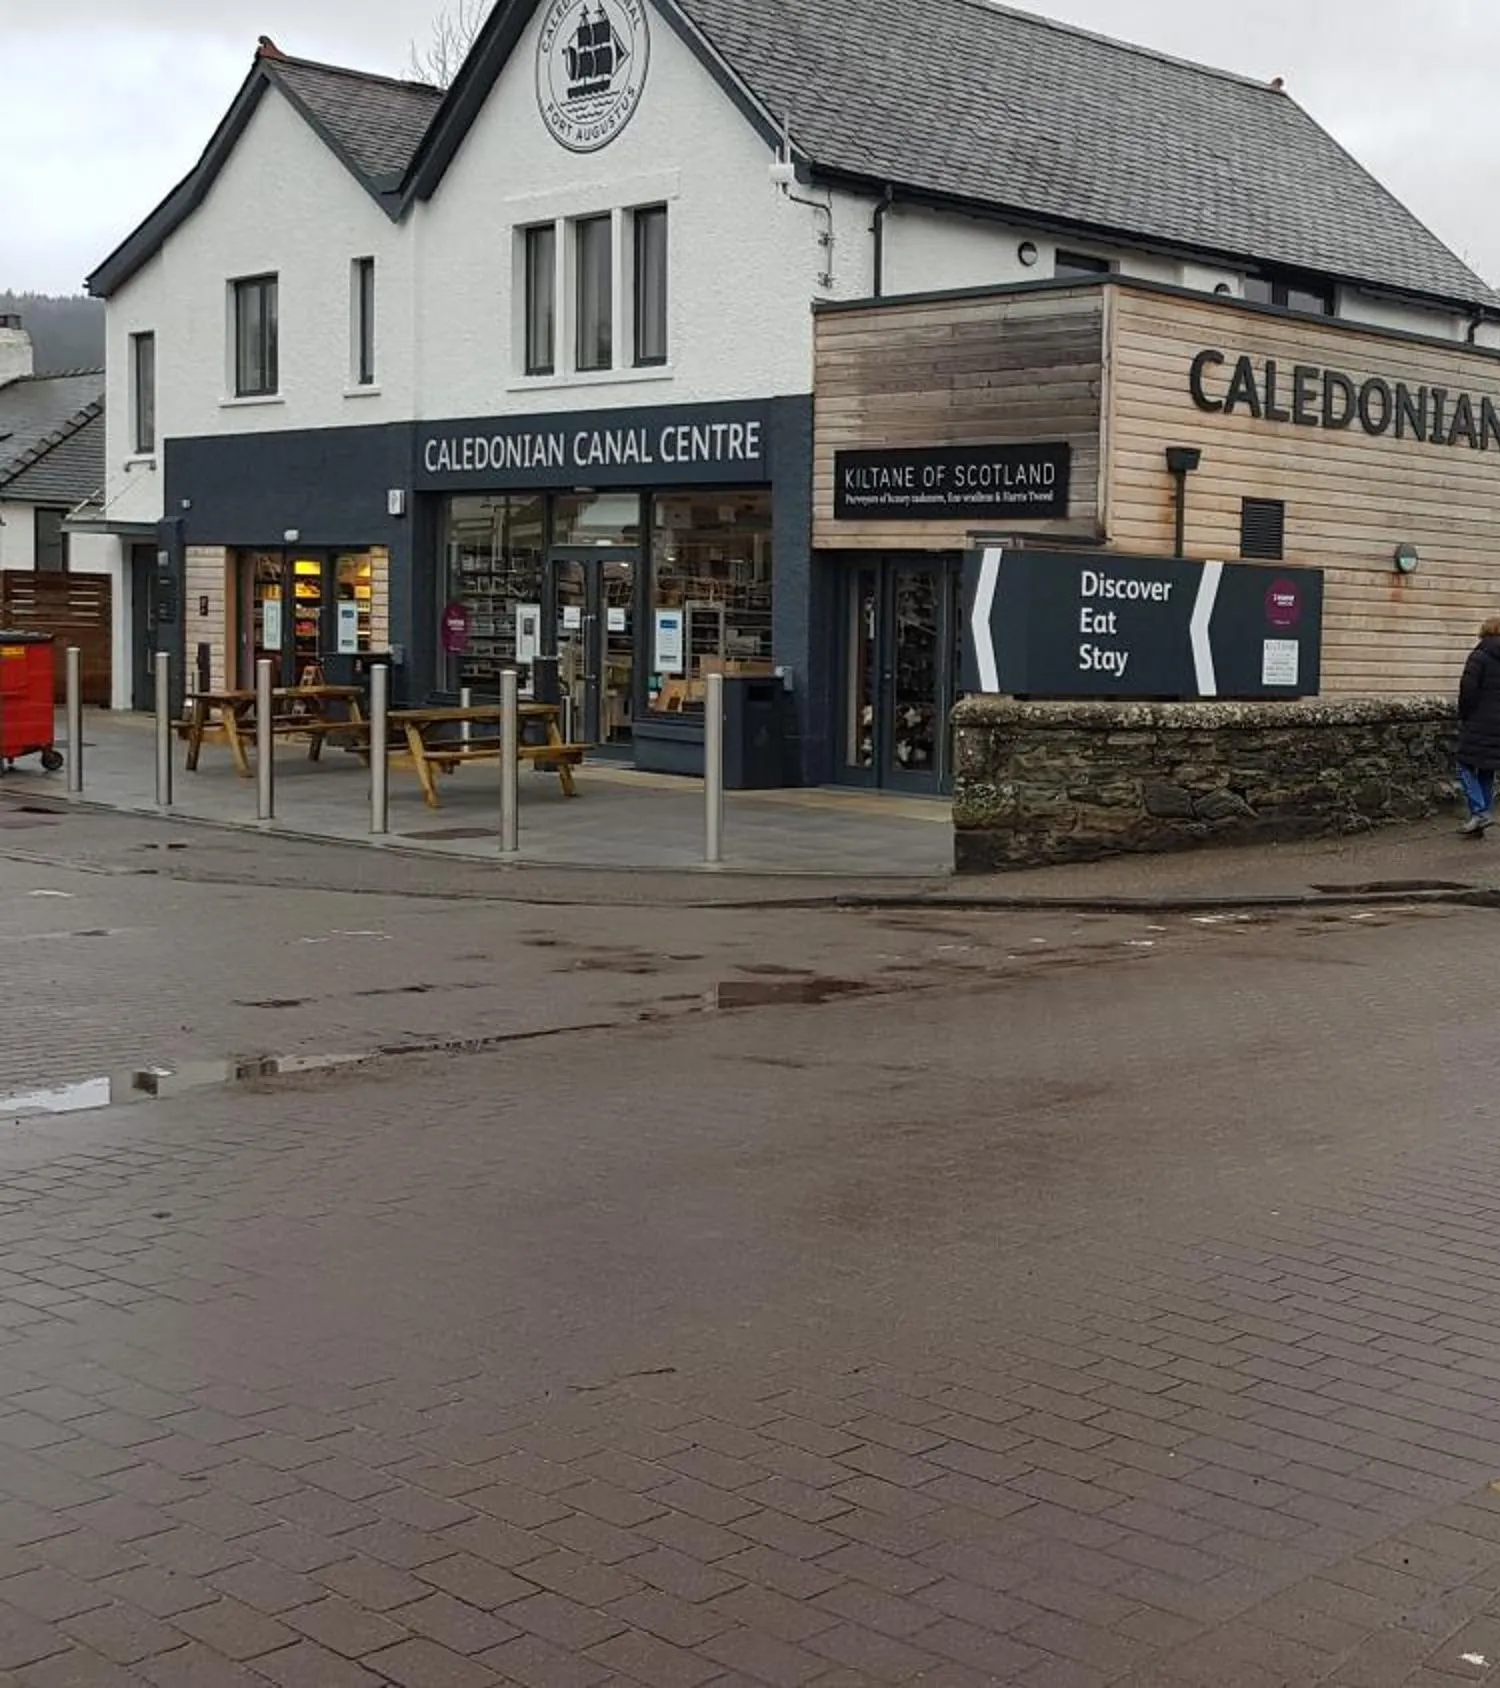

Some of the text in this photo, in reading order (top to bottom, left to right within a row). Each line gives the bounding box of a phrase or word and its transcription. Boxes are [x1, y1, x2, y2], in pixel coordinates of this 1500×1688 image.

[547, 86, 635, 142] FORT AUGUSTUS
[424, 421, 761, 473] CALEDONIAN CANAL CENTRE
[845, 463, 1056, 489] KILTANE OF SCOTLAND
[1080, 570, 1173, 601] Discover
[1079, 607, 1117, 634] Eat
[1079, 643, 1129, 677] Stay
